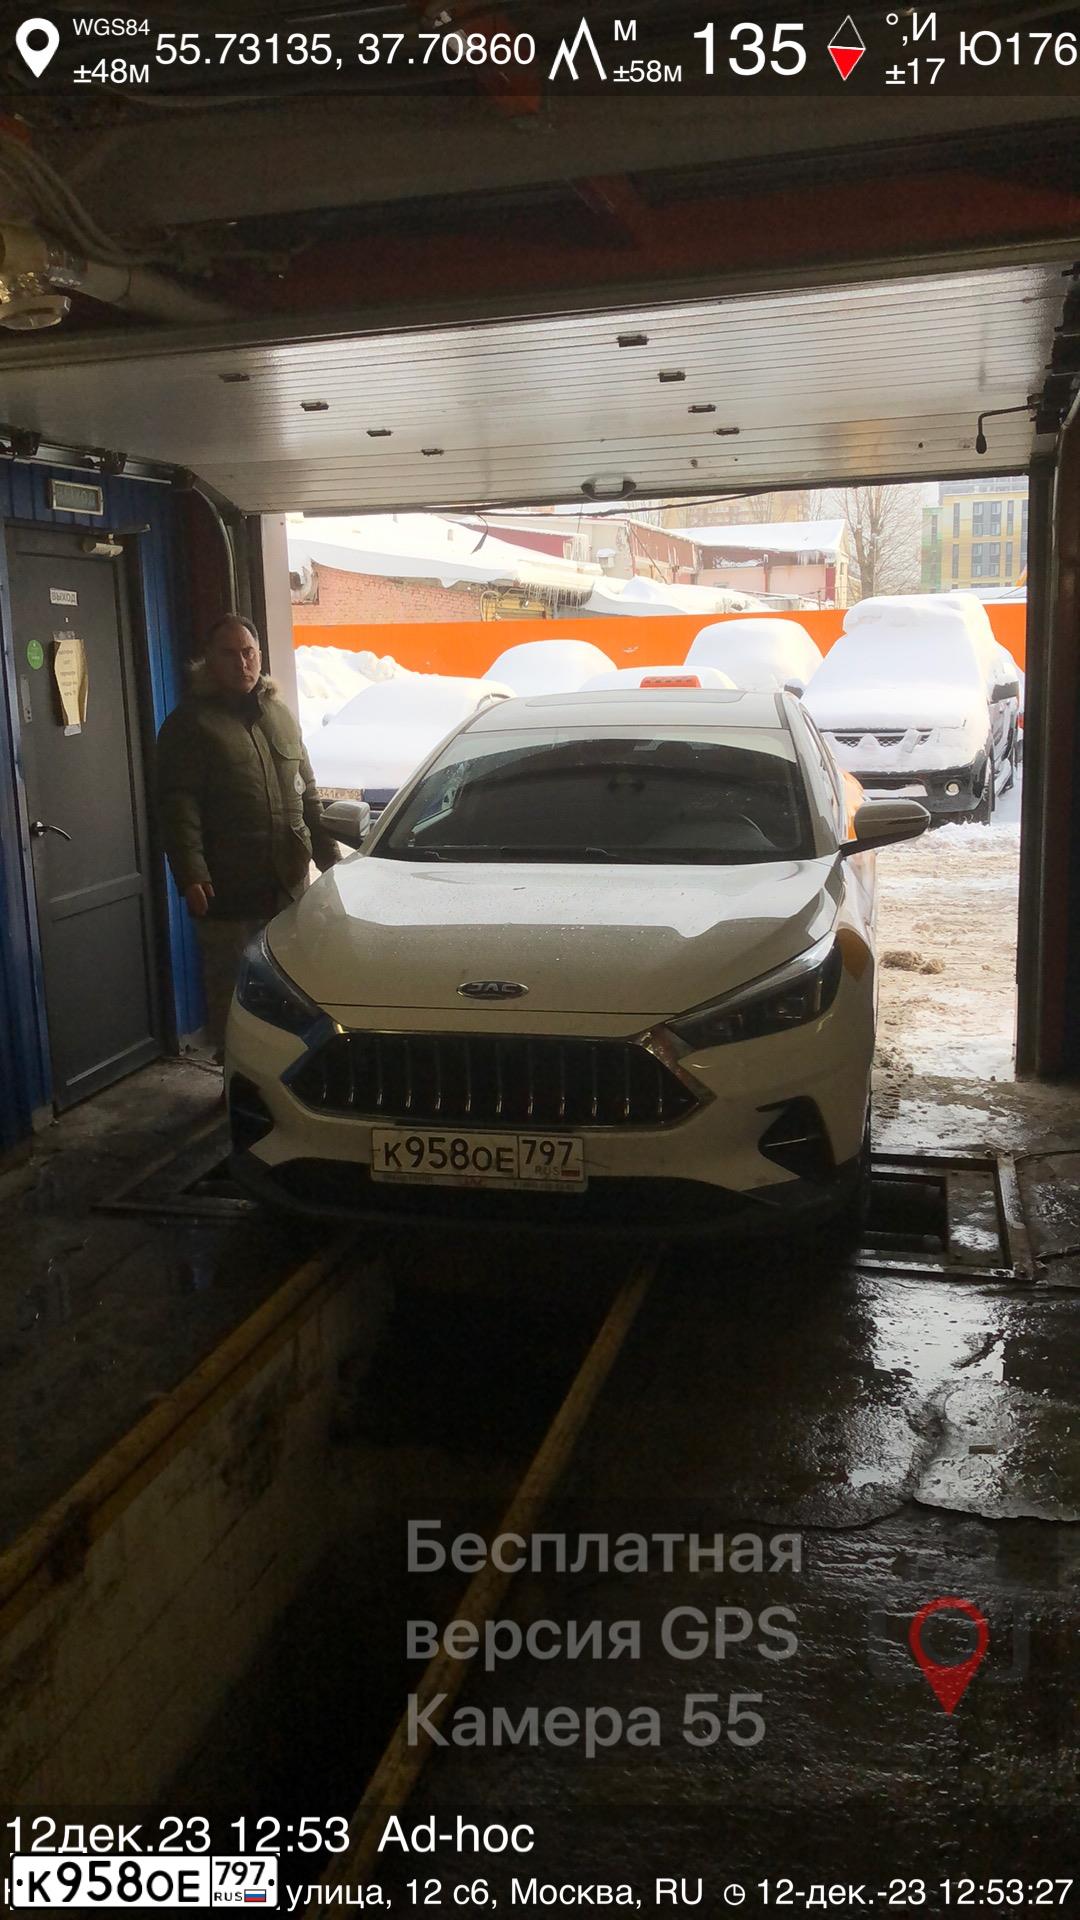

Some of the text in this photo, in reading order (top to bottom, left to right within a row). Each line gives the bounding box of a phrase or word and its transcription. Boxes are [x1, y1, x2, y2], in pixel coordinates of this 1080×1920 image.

[51, 591, 76, 603] ВЫХОД
[467, 982, 518, 993] JAC
[383, 1136, 574, 1173] К958ОЕ 797
[534, 1166, 560, 1176] RUS
